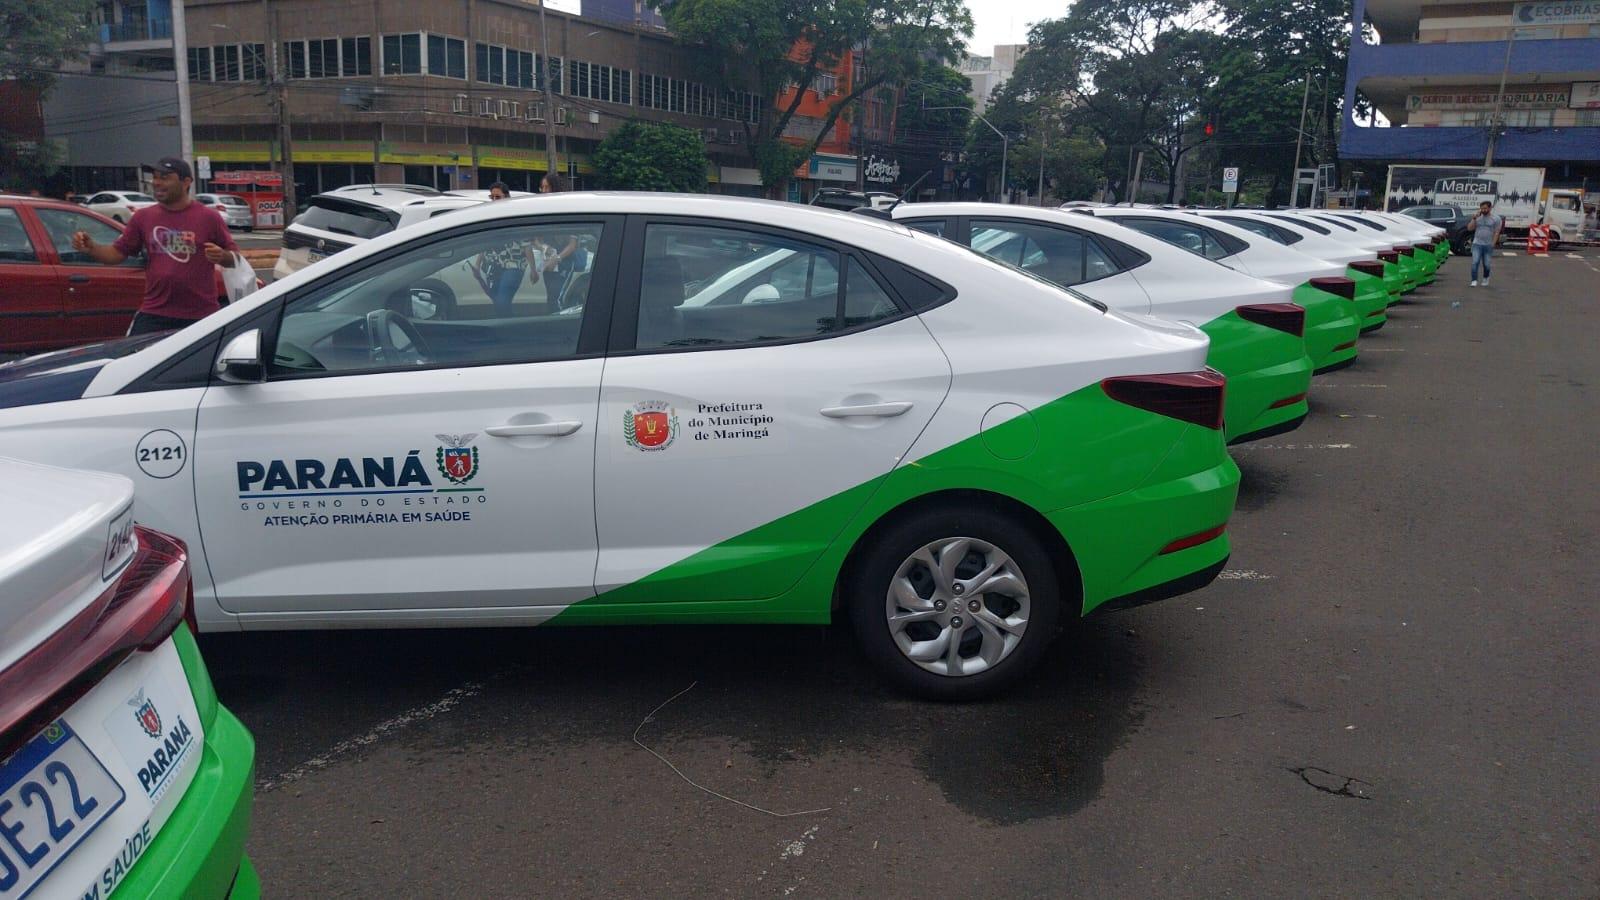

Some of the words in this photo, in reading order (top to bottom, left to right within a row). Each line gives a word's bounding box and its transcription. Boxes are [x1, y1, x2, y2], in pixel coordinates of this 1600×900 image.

[1442, 180, 1492, 194] Marçal
[698, 403, 763, 414] Prefeitura
[688, 418, 704, 428] do
[708, 414, 774, 428] Município
[694, 431, 709, 441] de
[713, 426, 769, 440] Maringá
[139, 446, 181, 462] 2121
[236, 450, 433, 492] PARANÁ
[241, 500, 342, 511] GOVERNO
[361, 498, 385, 507] DO
[404, 495, 487, 506] ESTADO
[264, 513, 329, 527] ATENÇÃO
[333, 511, 399, 525] PRIMÁRIA
[402, 512, 421, 523] EM
[425, 509, 471, 522] SAÚDE
[137, 715, 191, 793] PARANÁ
[103, 819, 152, 894] SAÚDE
